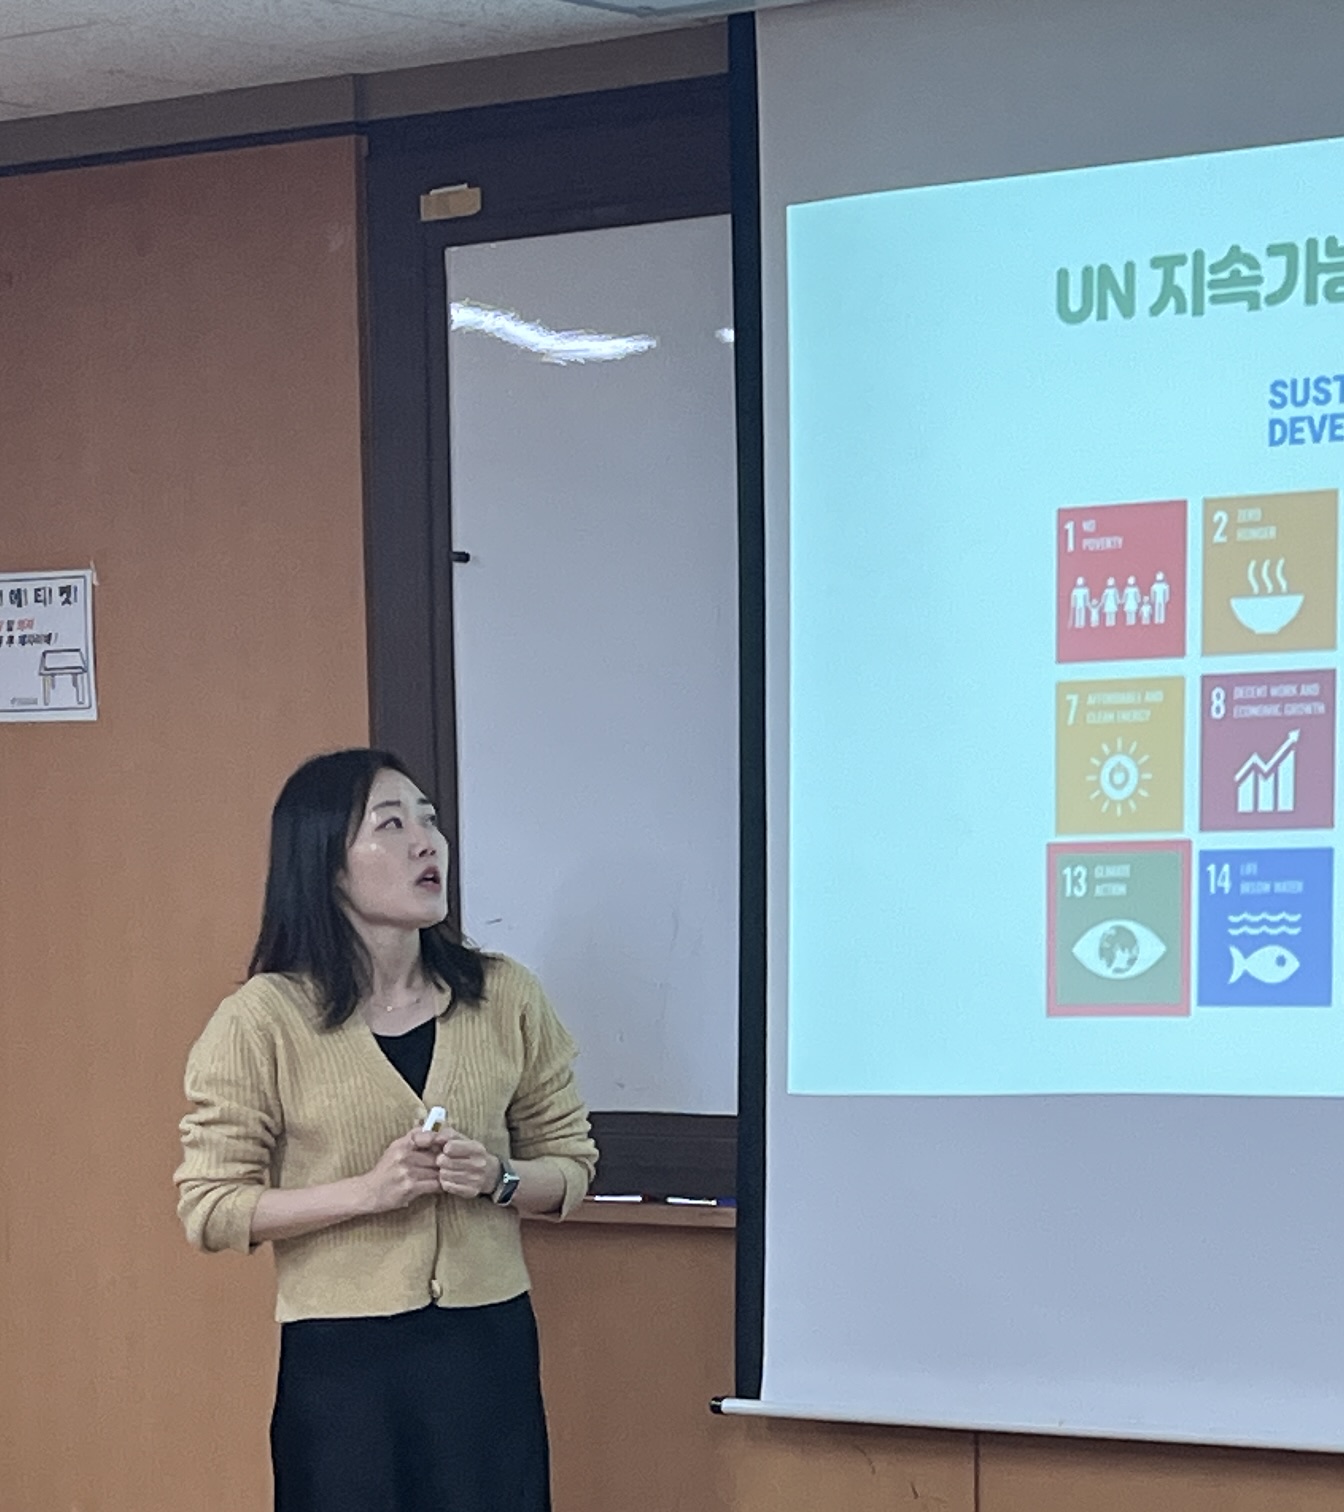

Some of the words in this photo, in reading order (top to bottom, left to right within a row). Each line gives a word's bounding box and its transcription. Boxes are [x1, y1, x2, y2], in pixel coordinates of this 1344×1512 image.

[1056, 260, 1136, 325] UN
[1064, 520, 1075, 553] 1
[1213, 510, 1229, 544] 2
[1065, 694, 1080, 726] 7
[1211, 686, 1226, 720] 8
[1062, 864, 1087, 898] 13
[1206, 863, 1232, 895] 14
